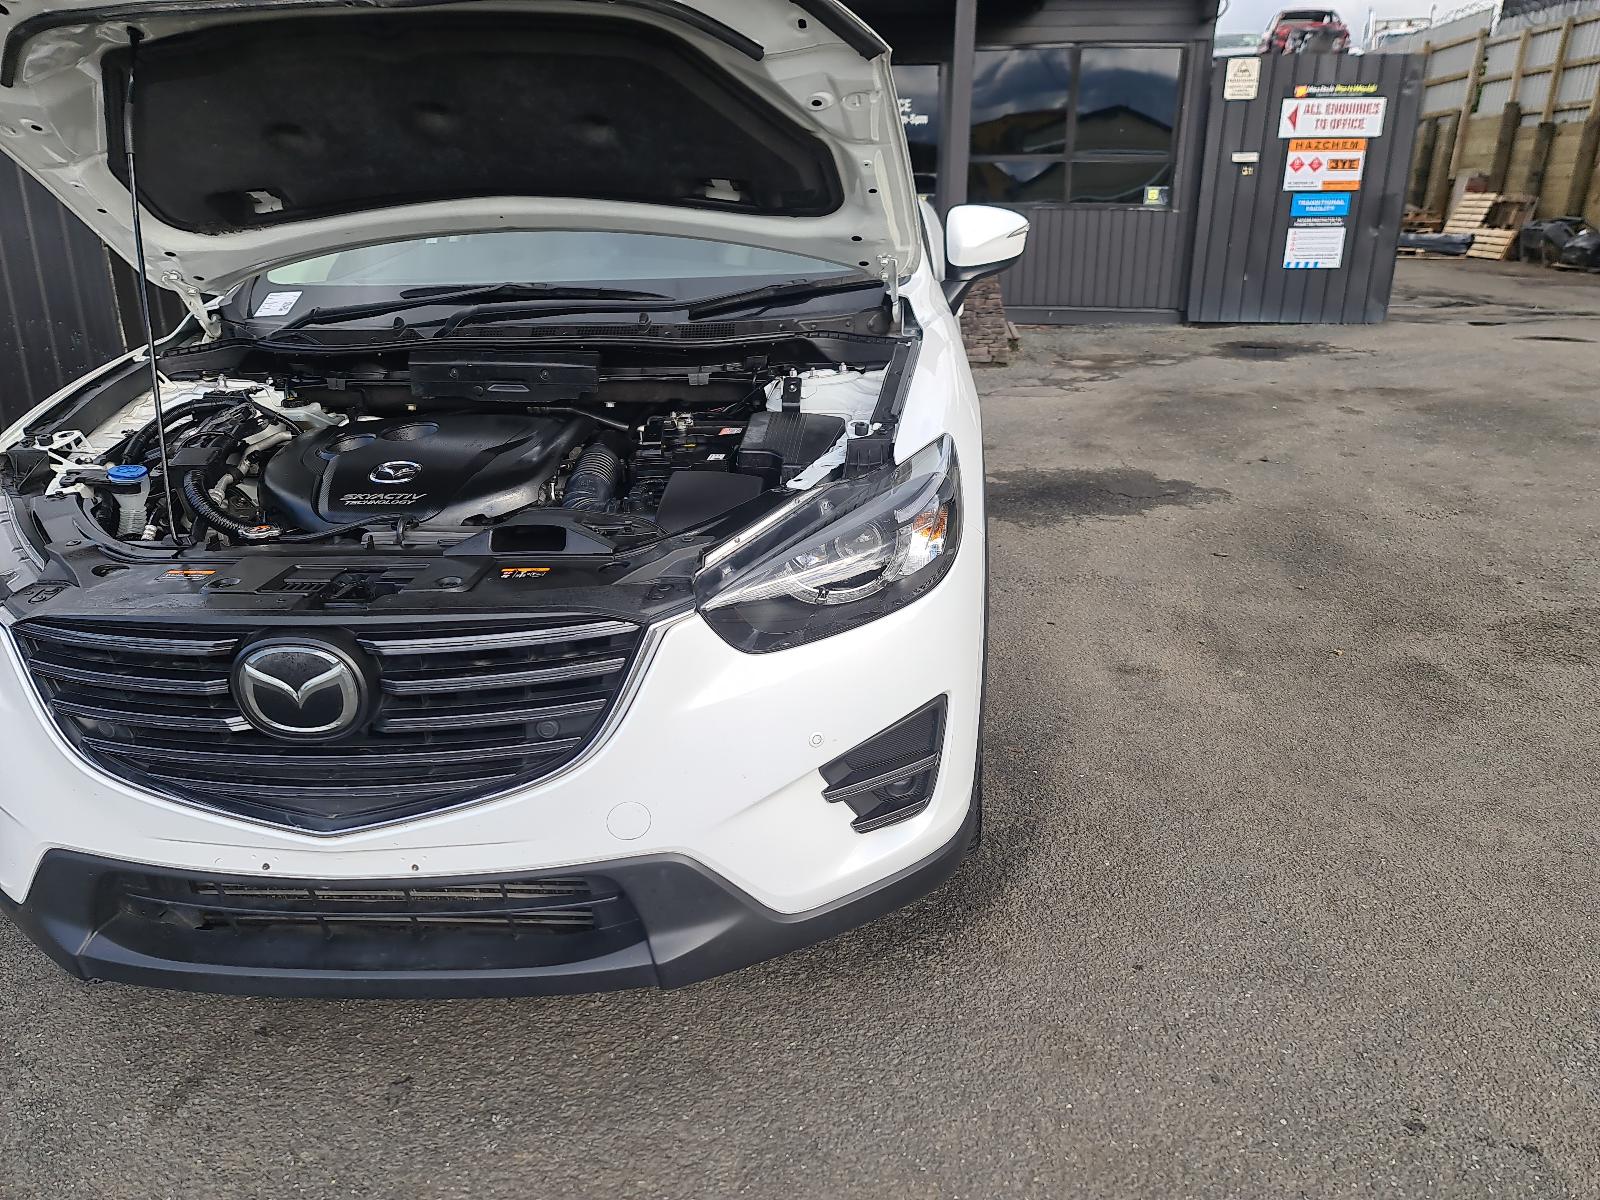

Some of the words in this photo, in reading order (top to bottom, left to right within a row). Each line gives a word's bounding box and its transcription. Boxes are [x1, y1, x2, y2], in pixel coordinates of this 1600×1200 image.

[1303, 102, 1322, 115] ALL
[1325, 102, 1381, 115] ENQUIRIES
[1314, 118, 1327, 130] TO
[1330, 118, 1365, 130] OFFICE
[1295, 141, 1359, 150] HAZCHEM
[340, 493, 428, 501] SKYACTIV
